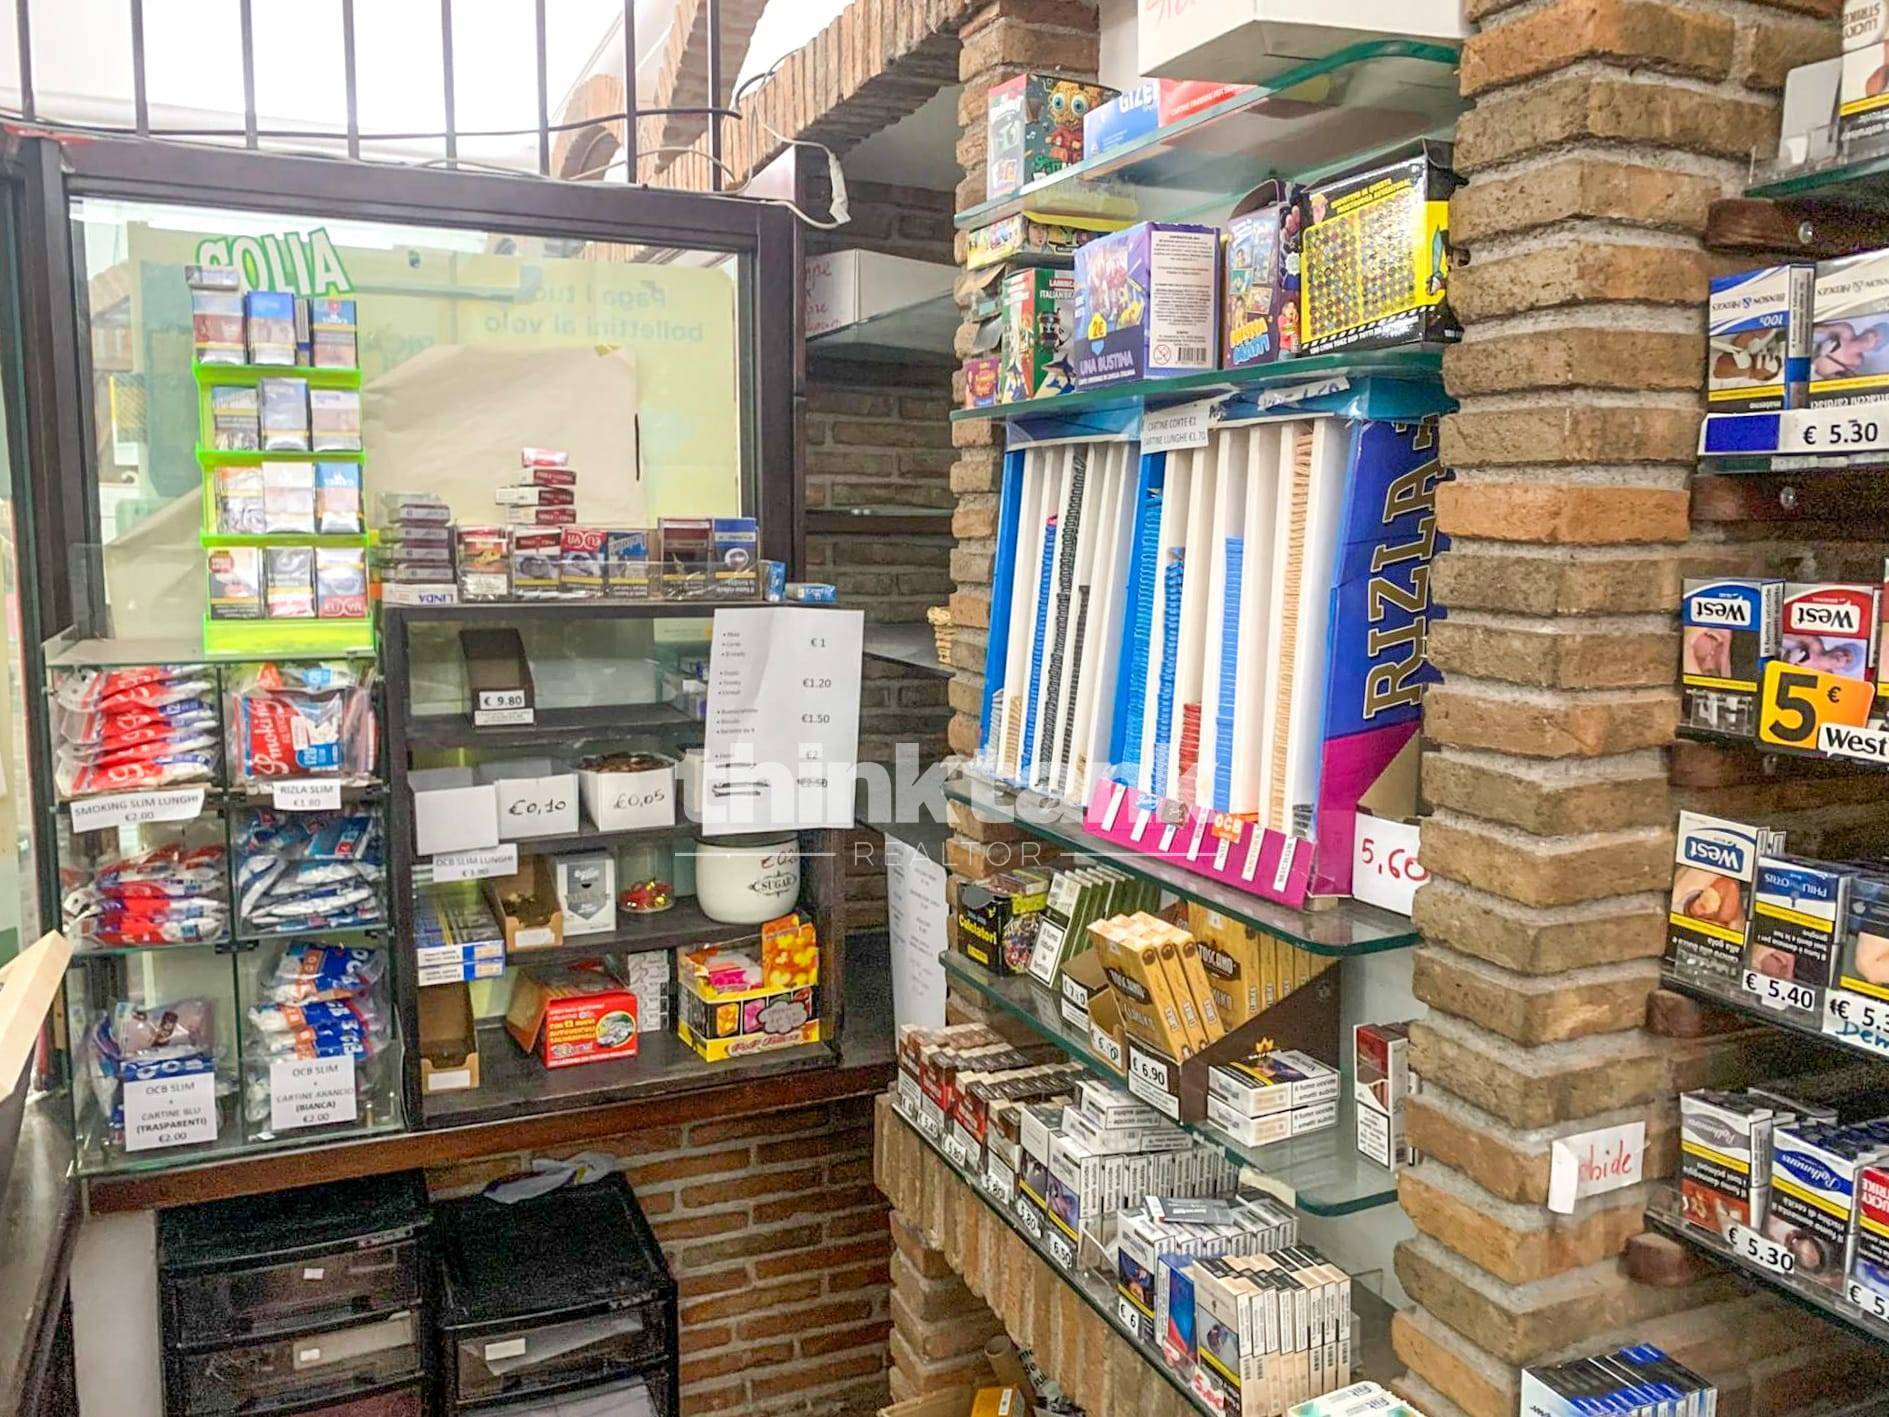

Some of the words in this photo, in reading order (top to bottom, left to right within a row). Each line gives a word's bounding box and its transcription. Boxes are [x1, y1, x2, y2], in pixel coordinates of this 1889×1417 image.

[1843, 2, 1881, 26] STRIKE
[1843, 17, 1879, 40] LUCKY
[1097, 350, 1134, 373] BUSTINA
[1803, 426, 1817, 445] €
[1829, 422, 1879, 444] 5.30
[418, 592, 454, 604] LINDA
[1696, 601, 1747, 622] West
[1798, 607, 1855, 629] West
[802, 678, 832, 689] €1.20
[497, 695, 523, 707] 9.80
[1768, 671, 1819, 743] 5
[1826, 686, 1842, 704] €
[801, 713, 831, 725] €1.50
[1825, 726, 1888, 758] West
[280, 785, 308, 794] RIZLA
[309, 785, 334, 793] SLIM
[73, 800, 128, 818] SMOKING
[129, 797, 155, 811] SLIM
[156, 793, 200, 808] LUNGHI
[509, 798, 567, 817] €0,10
[1214, 814, 1243, 833] OCB
[457, 856, 479, 866] SLIM
[1687, 840, 1741, 872] West
[761, 877, 792, 890] SUGAR
[1764, 873, 1796, 888] ORRIS
[1796, 882, 1828, 898] PHILI
[1746, 972, 1758, 991] €
[1768, 979, 1814, 1009] 5.40
[292, 1067, 315, 1078] OCB
[316, 1064, 339, 1076] SLIM
[1141, 1062, 1166, 1087] 6.90
[145, 1083, 168, 1095] OCB
[169, 1081, 195, 1093] SLIM
[141, 1109, 182, 1122] CARTINE
[183, 1106, 202, 1117] BLU
[295, 1100, 337, 1113] (BIANCA)
[136, 1116, 208, 1135] (TRASPARENTI)
[1687, 1117, 1736, 1145] Rothmans
[1780, 1153, 1842, 1191] Rothmans
[1861, 1178, 1889, 1199] TRIKE
[1861, 1191, 1889, 1213] UCKY
[1727, 1226, 1739, 1246] €
[1747, 1238, 1794, 1272] 5.30
[1873, 1295, 1889, 1318] 5.
[1129, 1314, 1137, 1329] 6
